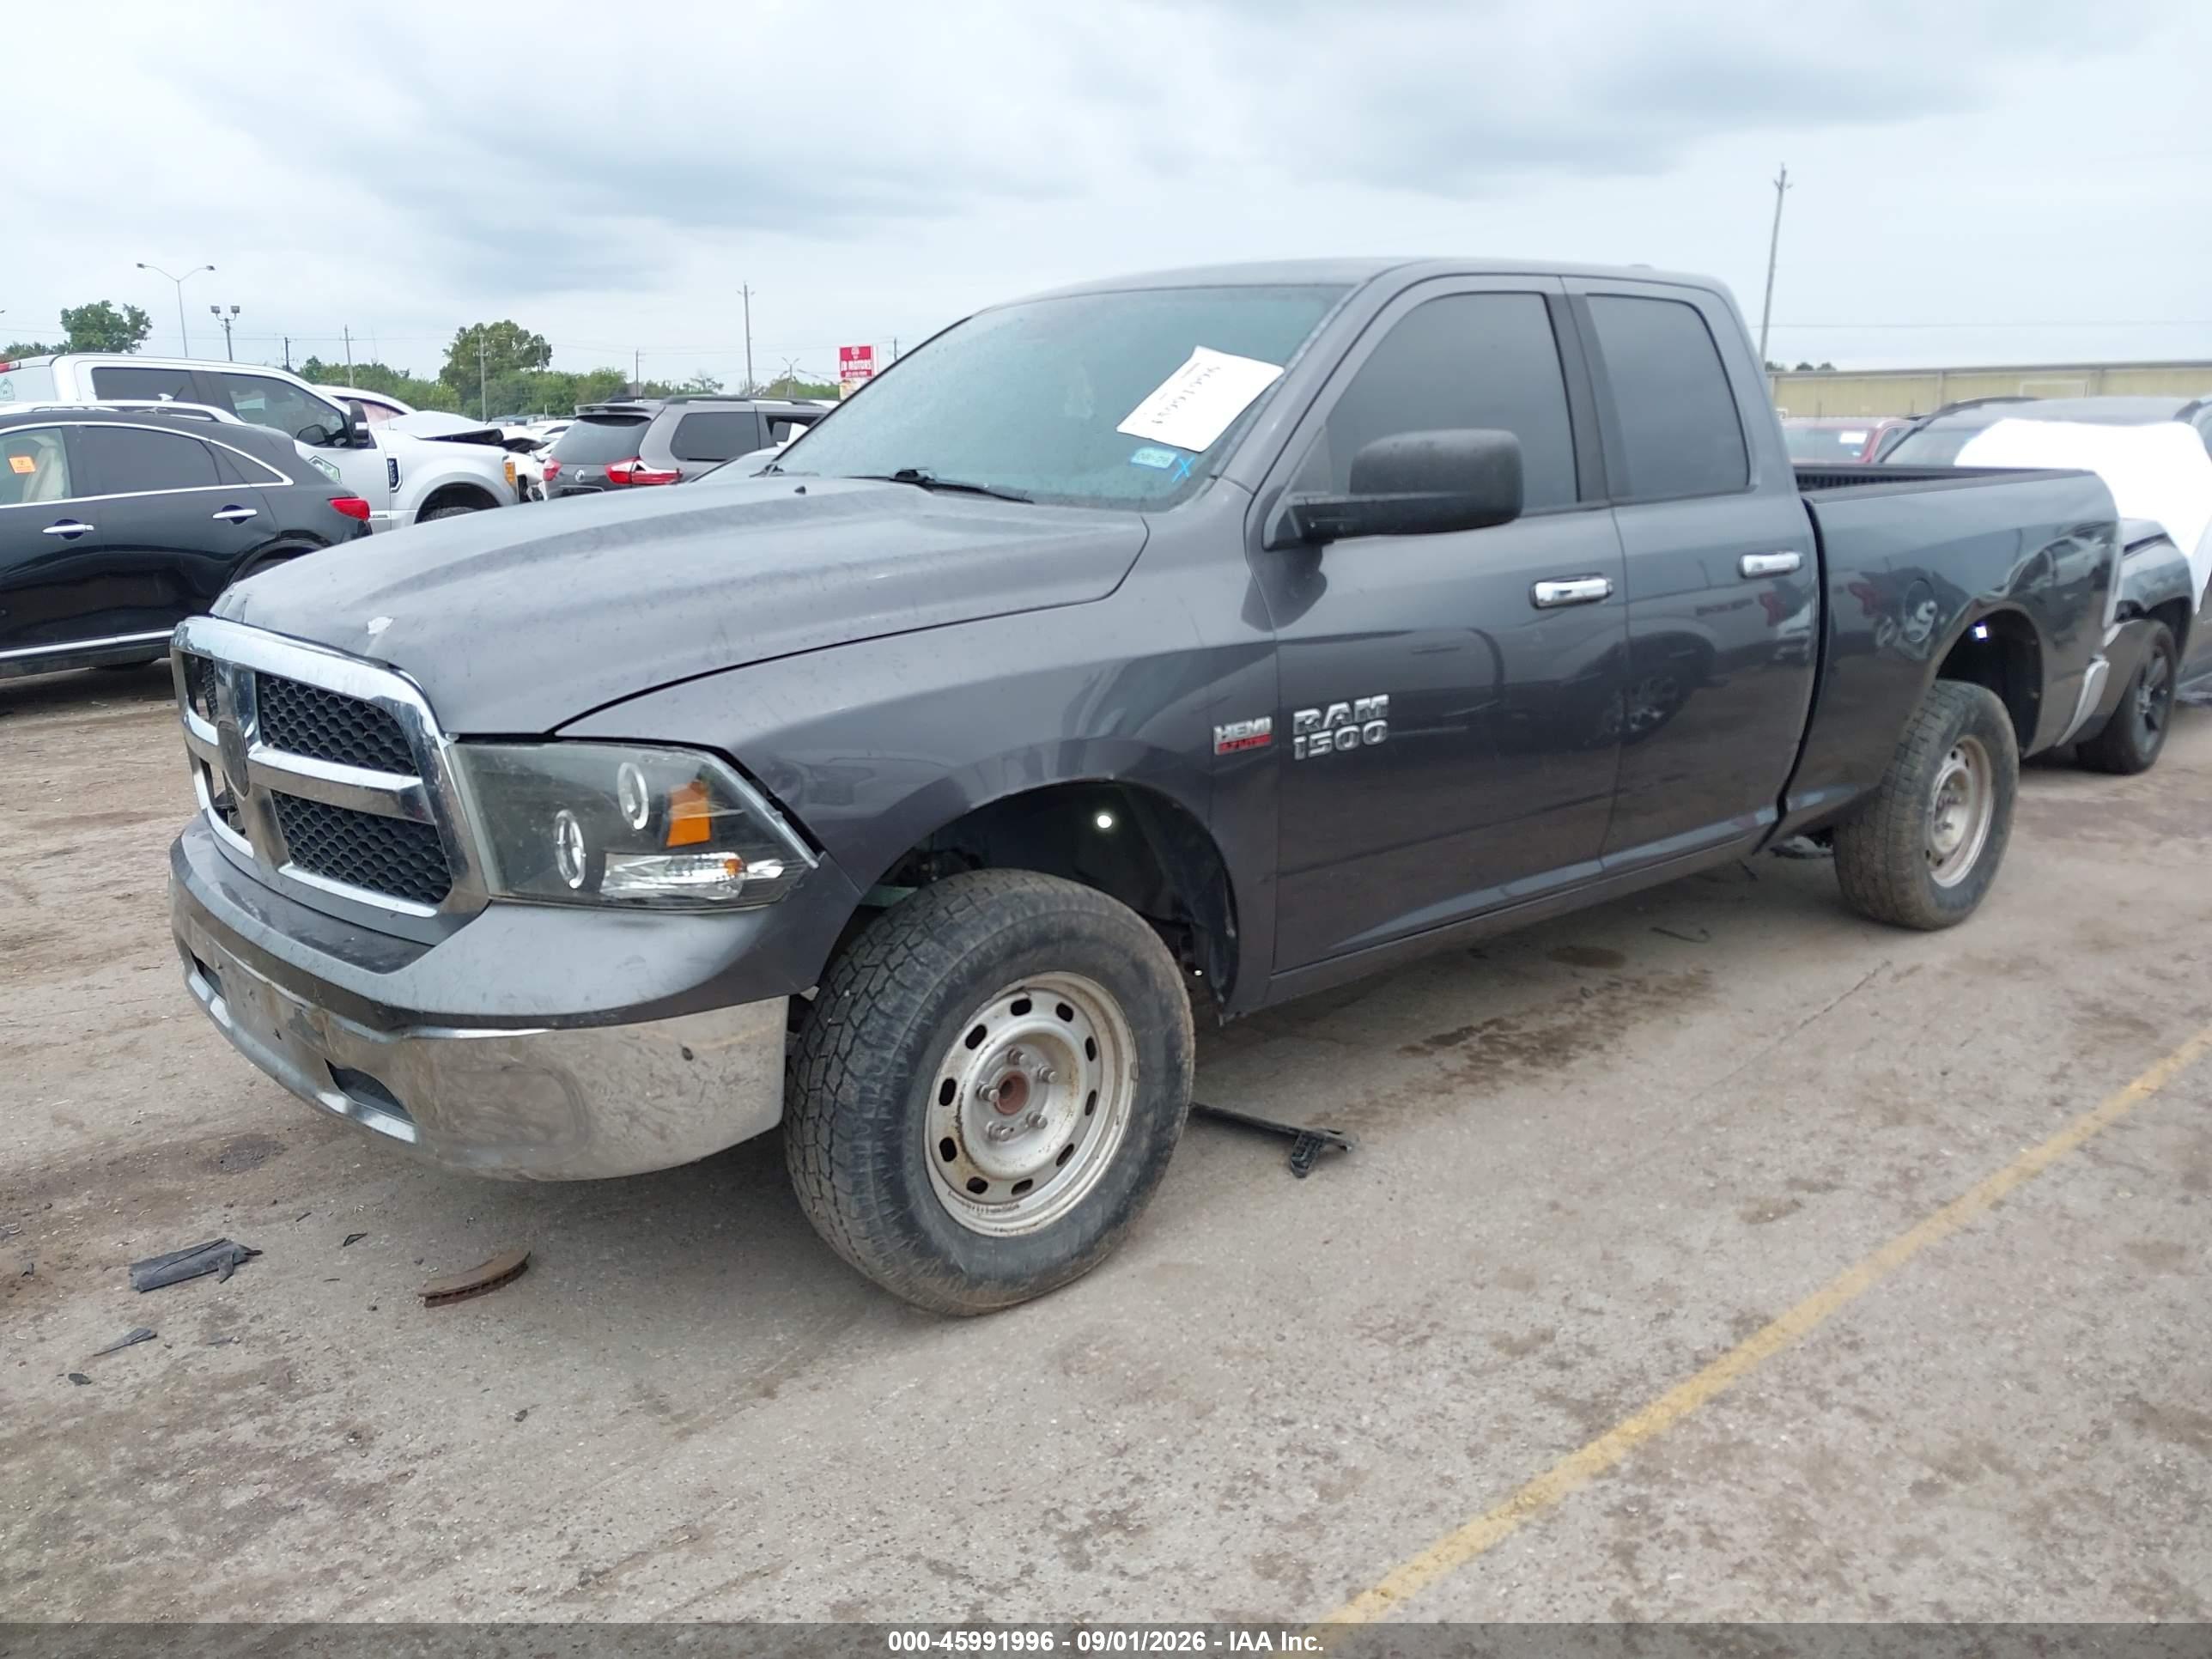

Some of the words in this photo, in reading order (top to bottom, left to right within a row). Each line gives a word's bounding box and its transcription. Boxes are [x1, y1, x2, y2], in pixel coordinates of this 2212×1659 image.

[1213, 716, 1273, 744] HEMI
[1293, 694, 1389, 736] RAM
[1294, 720, 1389, 761] 1500
